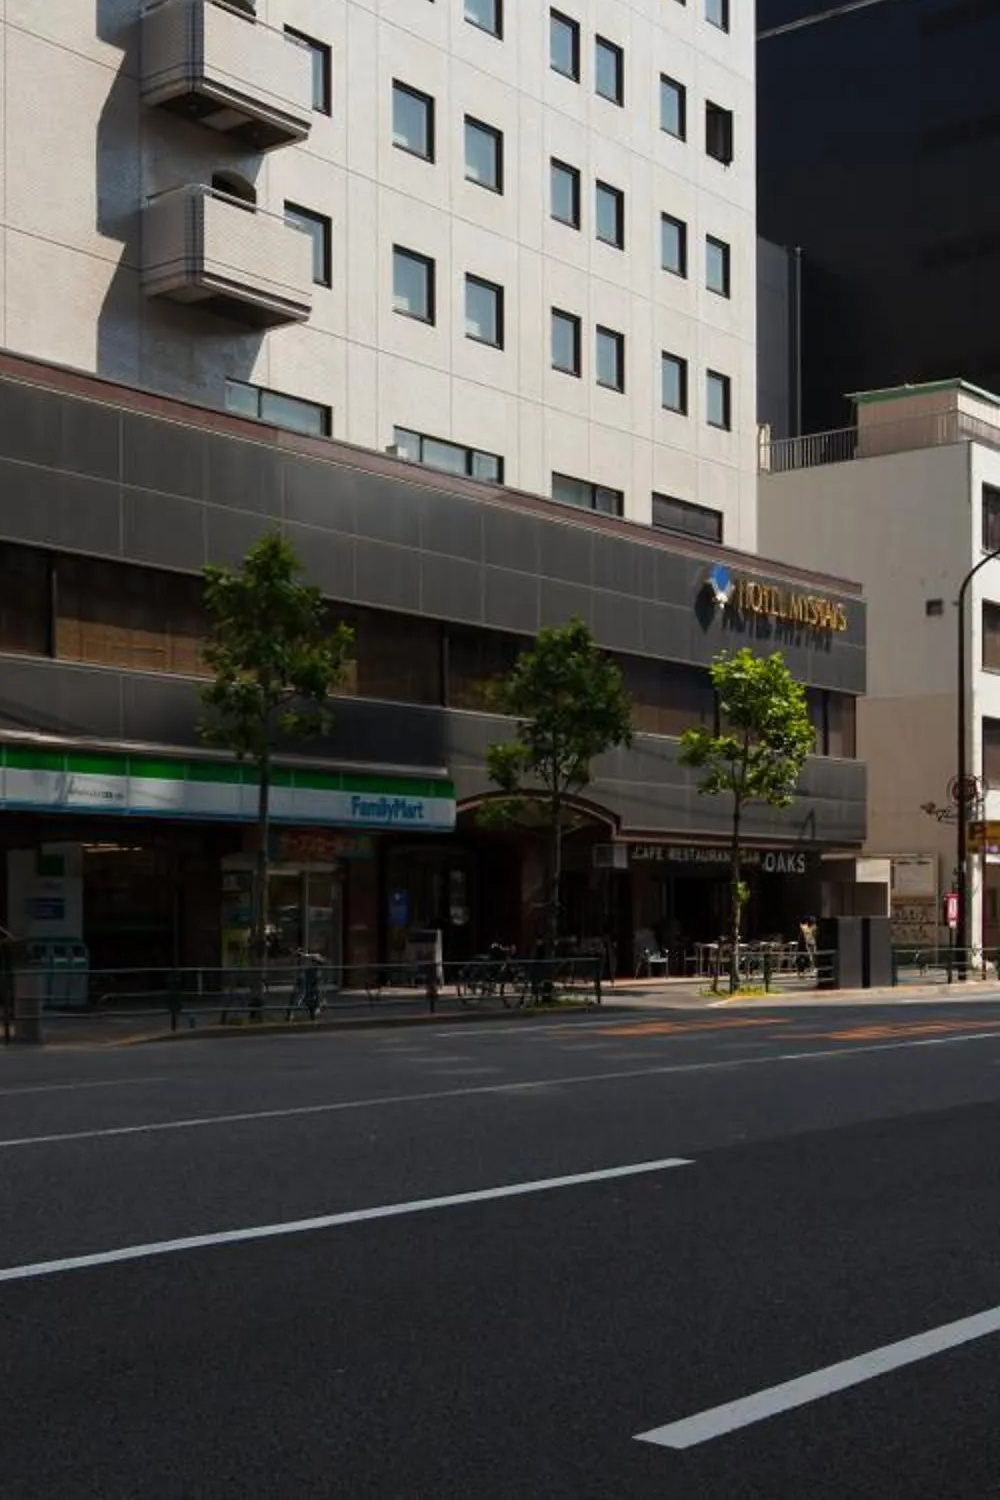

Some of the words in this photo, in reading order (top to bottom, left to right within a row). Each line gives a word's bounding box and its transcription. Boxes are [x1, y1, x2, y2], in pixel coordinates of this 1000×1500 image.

[738, 580, 788, 616] HOTEL
[790, 593, 848, 632] MYSTAYS
[352, 796, 424, 822] FamilyMart
[668, 847, 737, 863] RESTAURAN
[764, 852, 805, 873] OAKS
